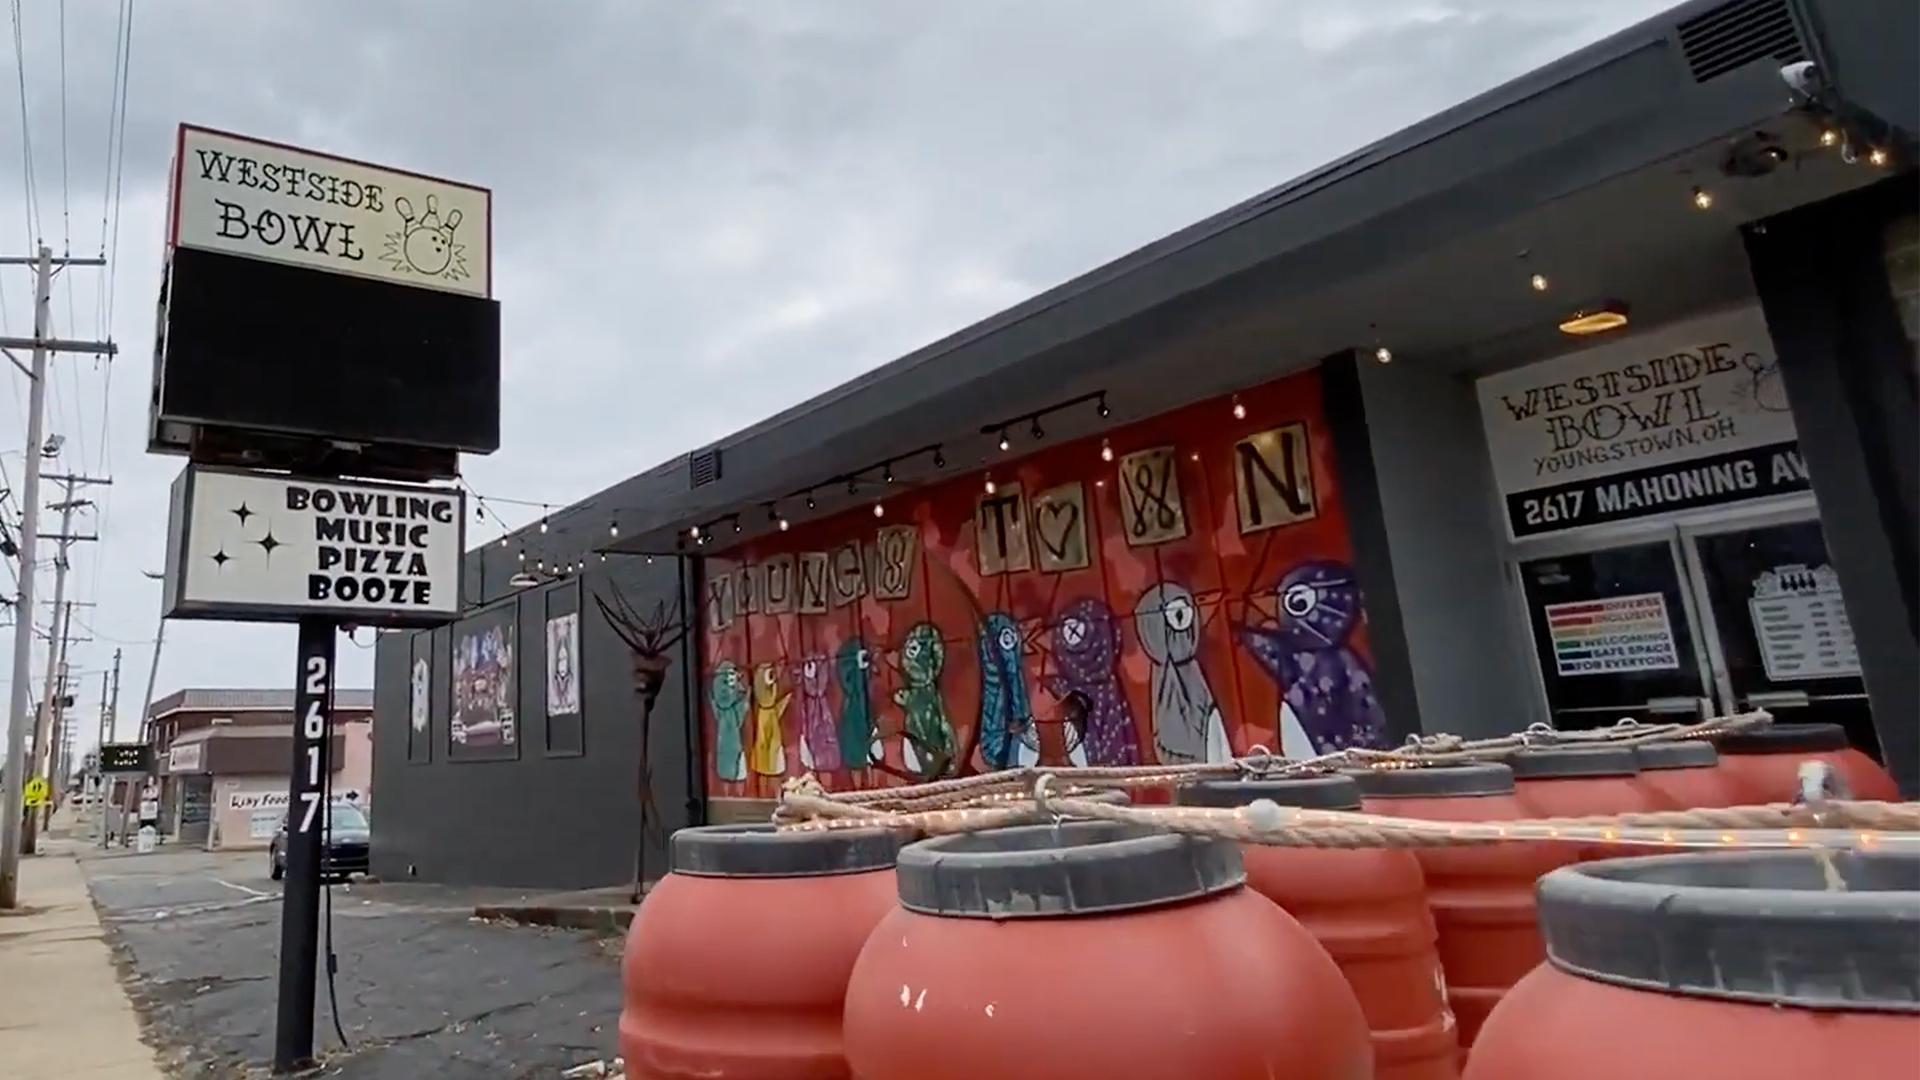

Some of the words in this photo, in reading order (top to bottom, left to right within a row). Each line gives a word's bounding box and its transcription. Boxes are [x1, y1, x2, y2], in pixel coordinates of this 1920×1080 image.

[196, 149, 385, 212] WESTSIDE
[214, 198, 364, 261] BOWL
[1500, 342, 1737, 421] WESTSIDE
[1546, 384, 1720, 452] BOWL
[286, 486, 453, 523] BOWLING
[1523, 489, 1584, 525] 2617
[1596, 458, 1758, 514] MAHONING
[315, 516, 429, 548] MUSIC
[318, 546, 428, 576] PIZZA
[308, 574, 431, 605] BOOZE
[1584, 632, 1668, 647] WELCOMING
[1593, 646, 1625, 658] SAFE
[1628, 643, 1672, 655] SPACE
[298, 656, 327, 833] 2617
